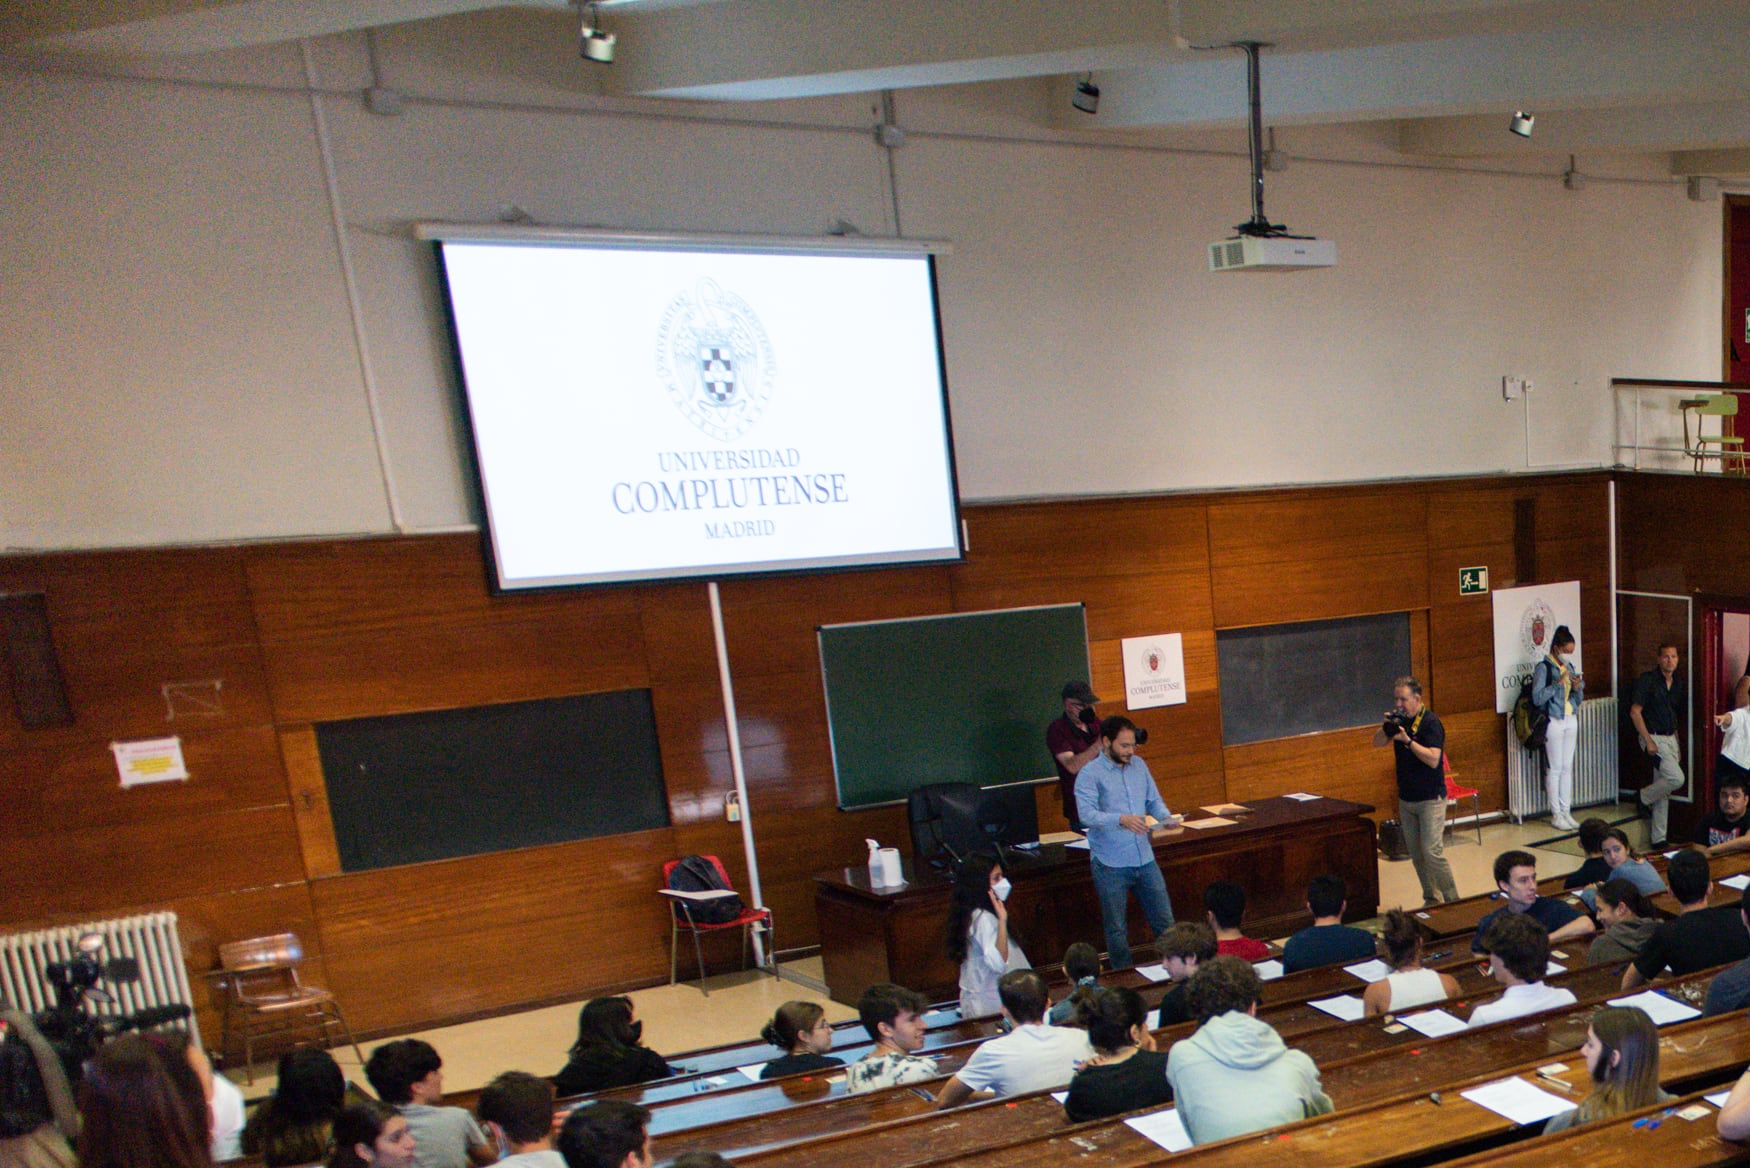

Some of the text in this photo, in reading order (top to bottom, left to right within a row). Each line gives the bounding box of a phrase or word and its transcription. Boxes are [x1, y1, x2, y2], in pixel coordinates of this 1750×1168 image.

[657, 447, 801, 473] UNIVERSIDAD
[612, 473, 850, 514] COMPLUTENSE
[704, 518, 776, 540] MADRID
